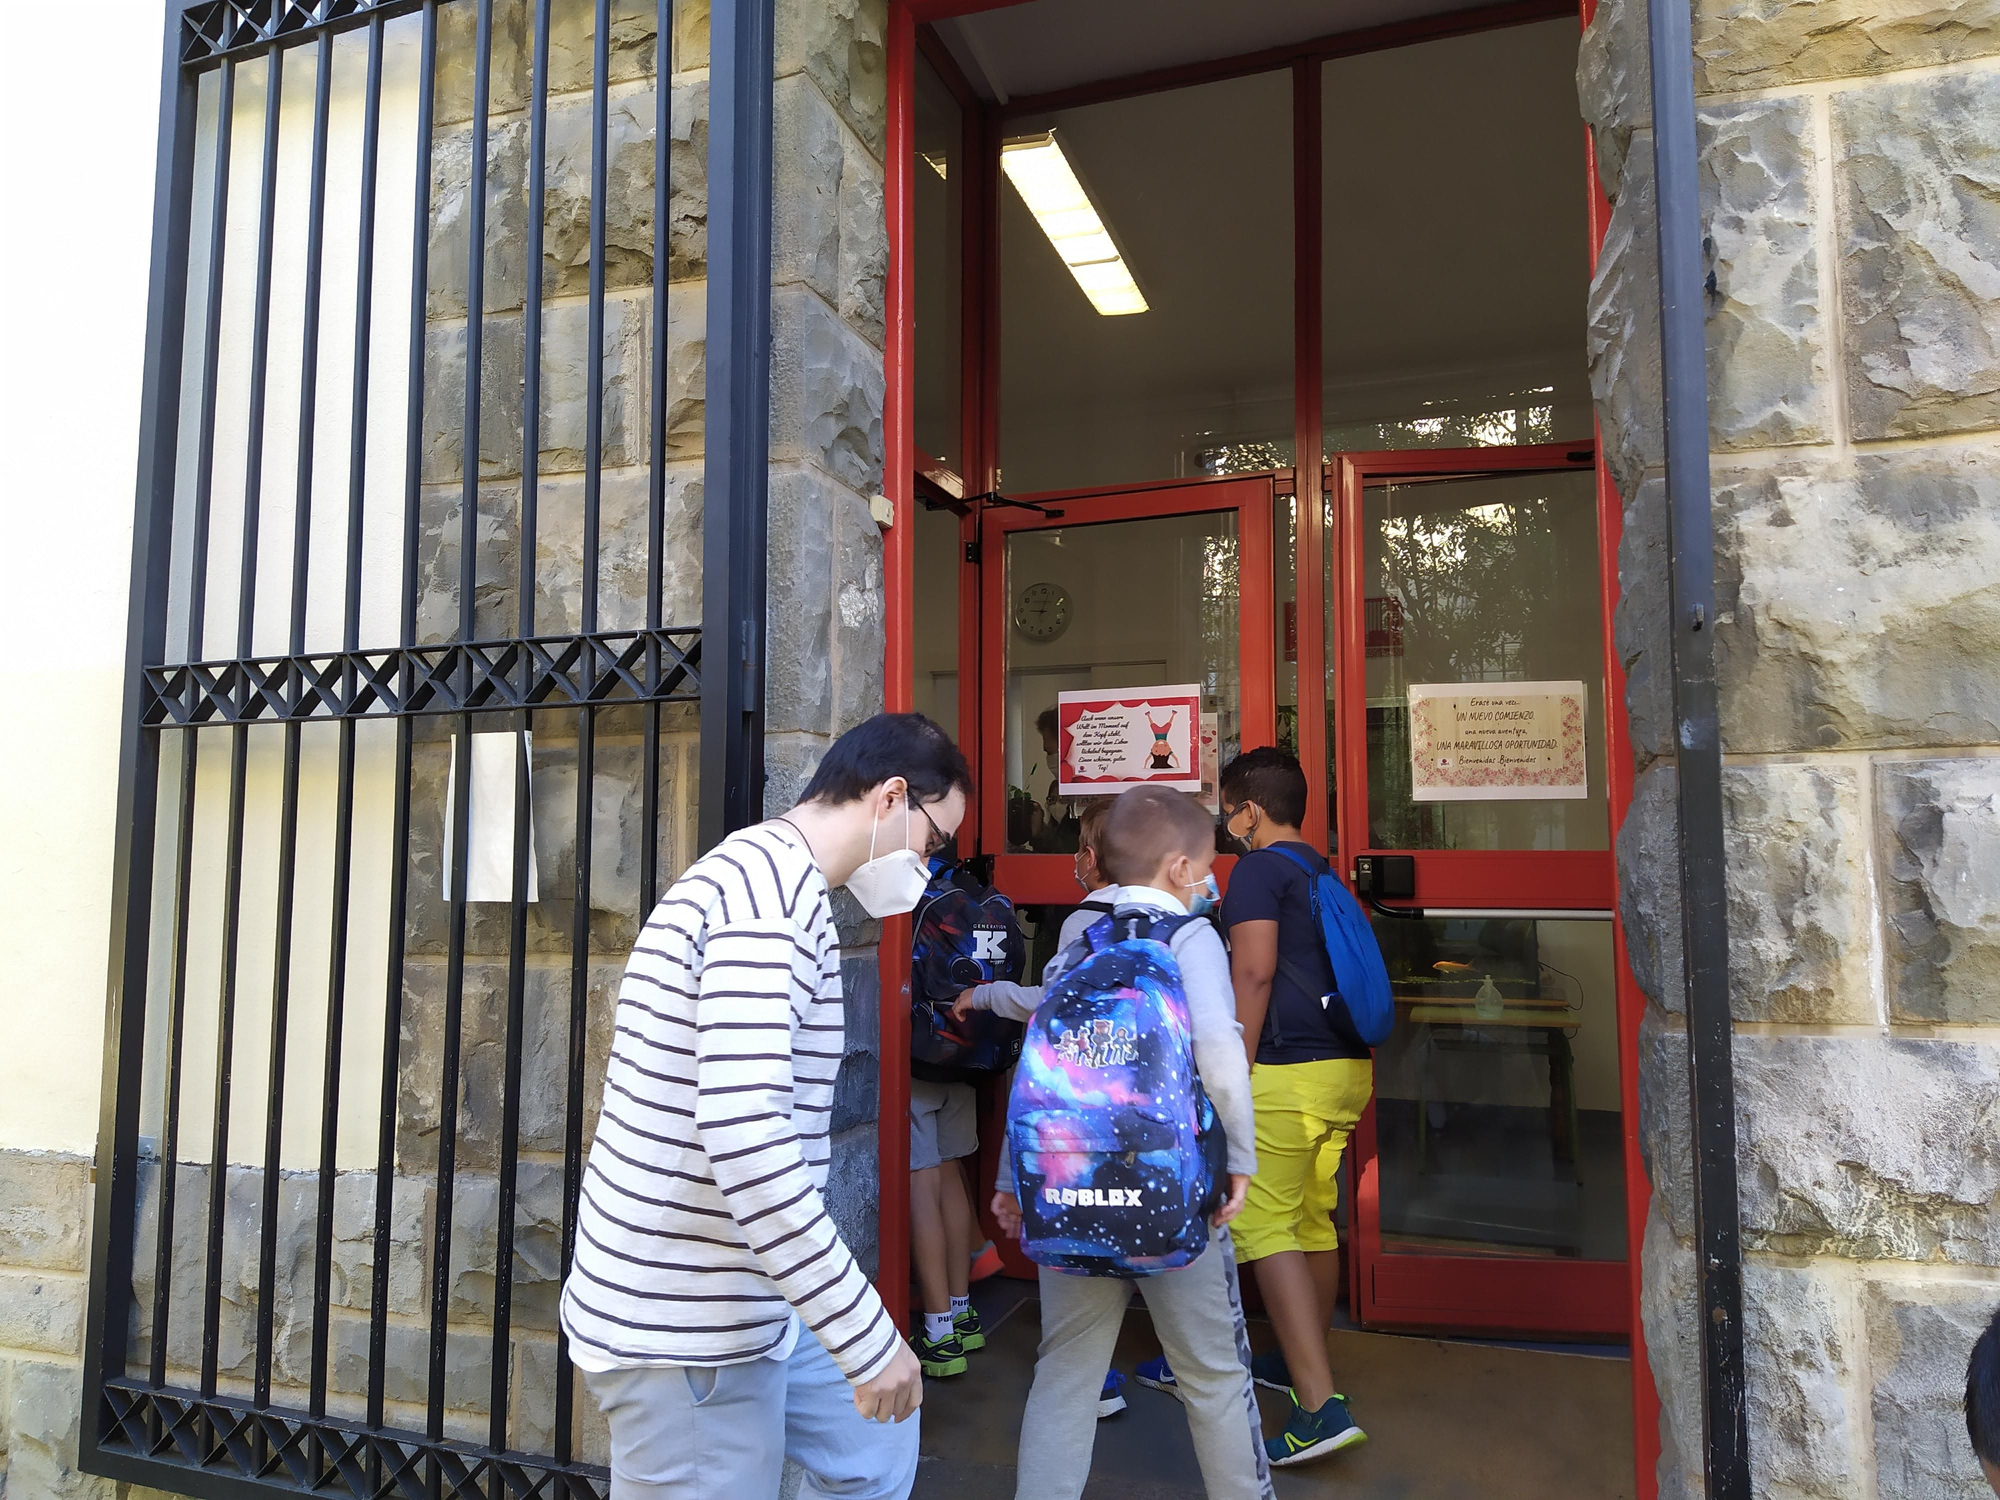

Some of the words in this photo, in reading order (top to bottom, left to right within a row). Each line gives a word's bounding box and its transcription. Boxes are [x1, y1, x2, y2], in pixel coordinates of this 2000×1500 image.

[1456, 711, 1468, 721] UN
[1469, 711, 1493, 721] NUEVO
[1120, 721, 1130, 729] auf
[1093, 730, 1108, 739] Kopf
[1436, 741, 1452, 750] UNA
[1453, 740, 1503, 750] MARAVILLOSA
[1112, 755, 1126, 764] guten
[1459, 755, 1495, 765] Bienvenidas
[1097, 764, 1109, 772] Tag!
[972, 930, 1007, 959] K
[1044, 1187, 1143, 1207] ROBLOX
